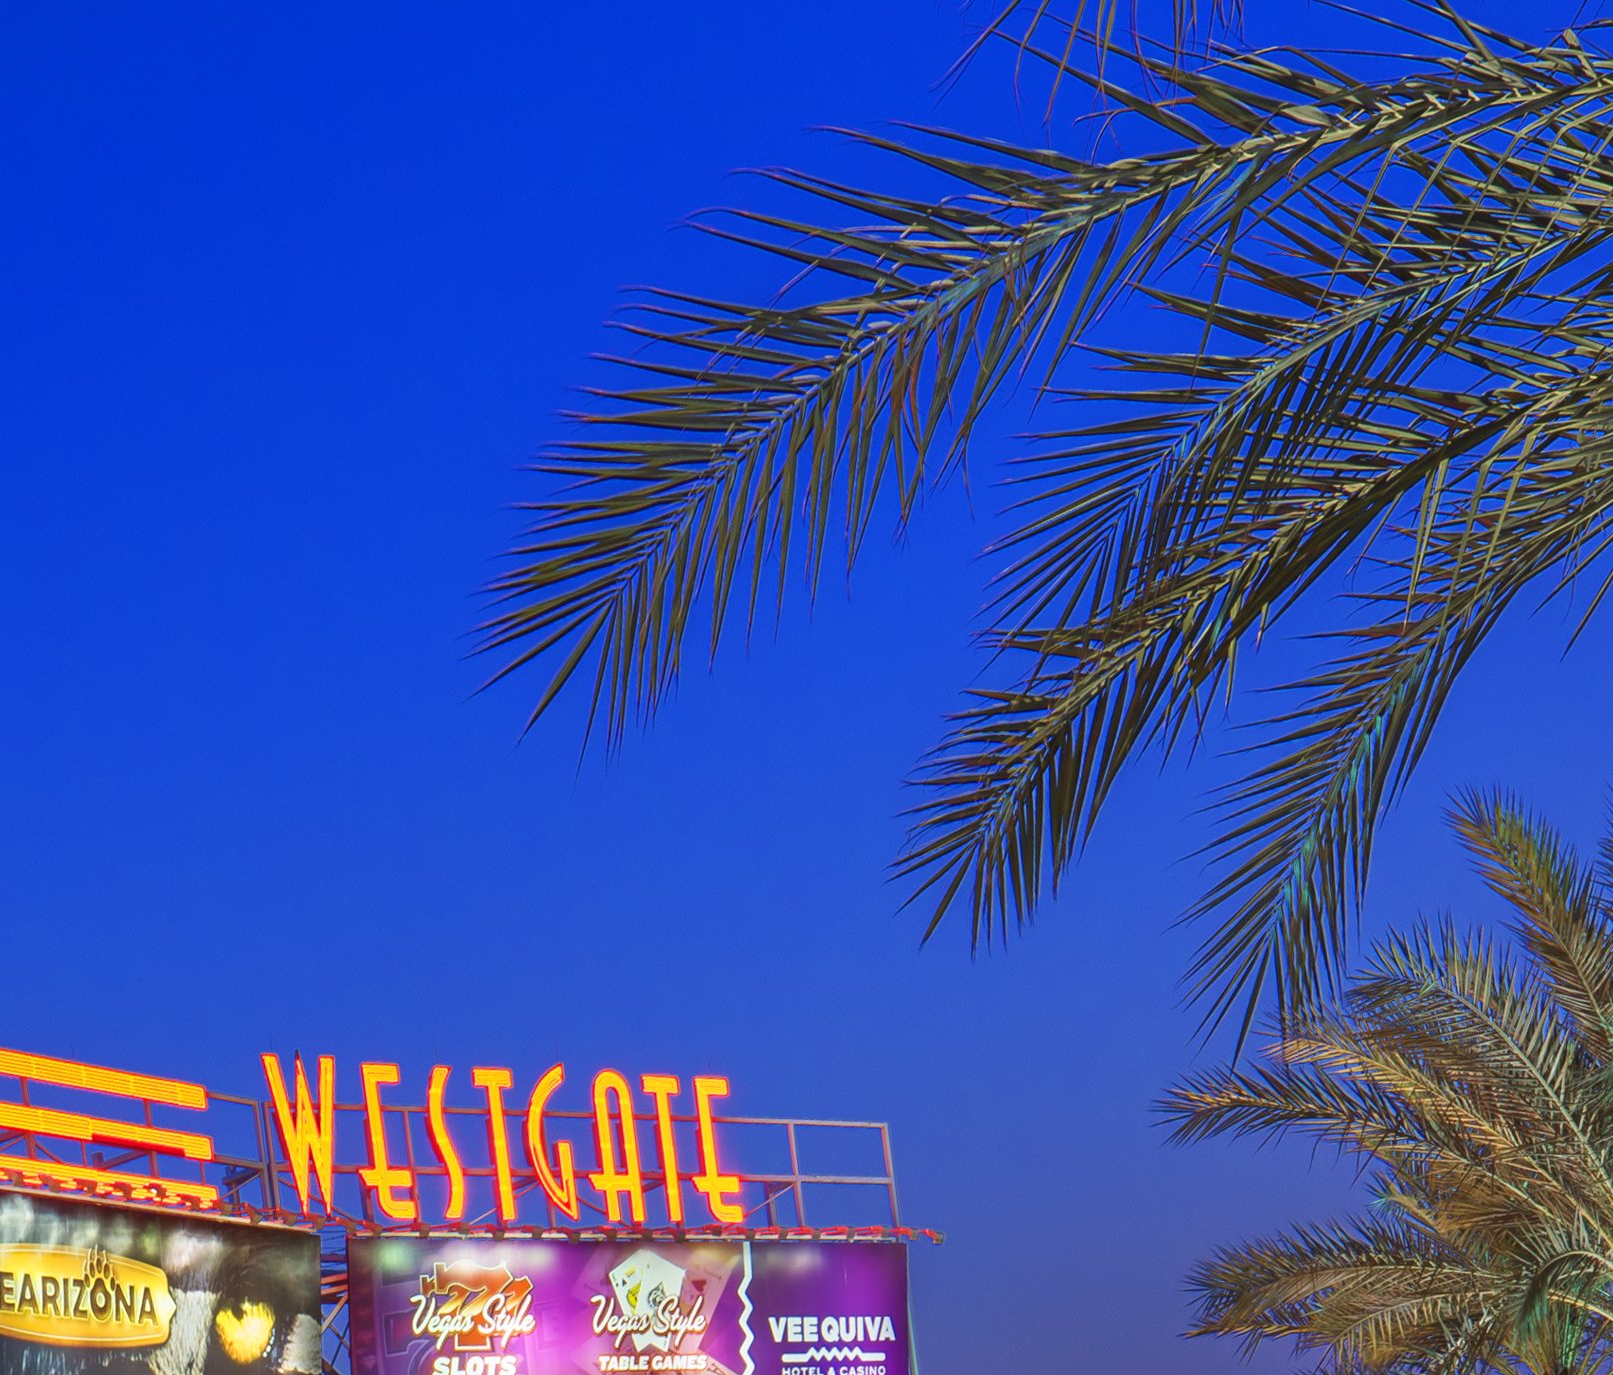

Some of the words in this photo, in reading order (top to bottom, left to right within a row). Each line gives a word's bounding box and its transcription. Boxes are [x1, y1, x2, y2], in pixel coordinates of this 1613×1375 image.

[260, 1050, 744, 1223] WESTGATE
[410, 1295, 478, 1349] Vegas
[477, 1295, 536, 1349] Style
[590, 1295, 650, 1347] Vegas
[648, 1295, 706, 1347] Style
[768, 1316, 819, 1343] VEE
[821, 1316, 896, 1342] QUIVA
[598, 1354, 649, 1373] TABLE
[651, 1354, 707, 1373] GAMES
